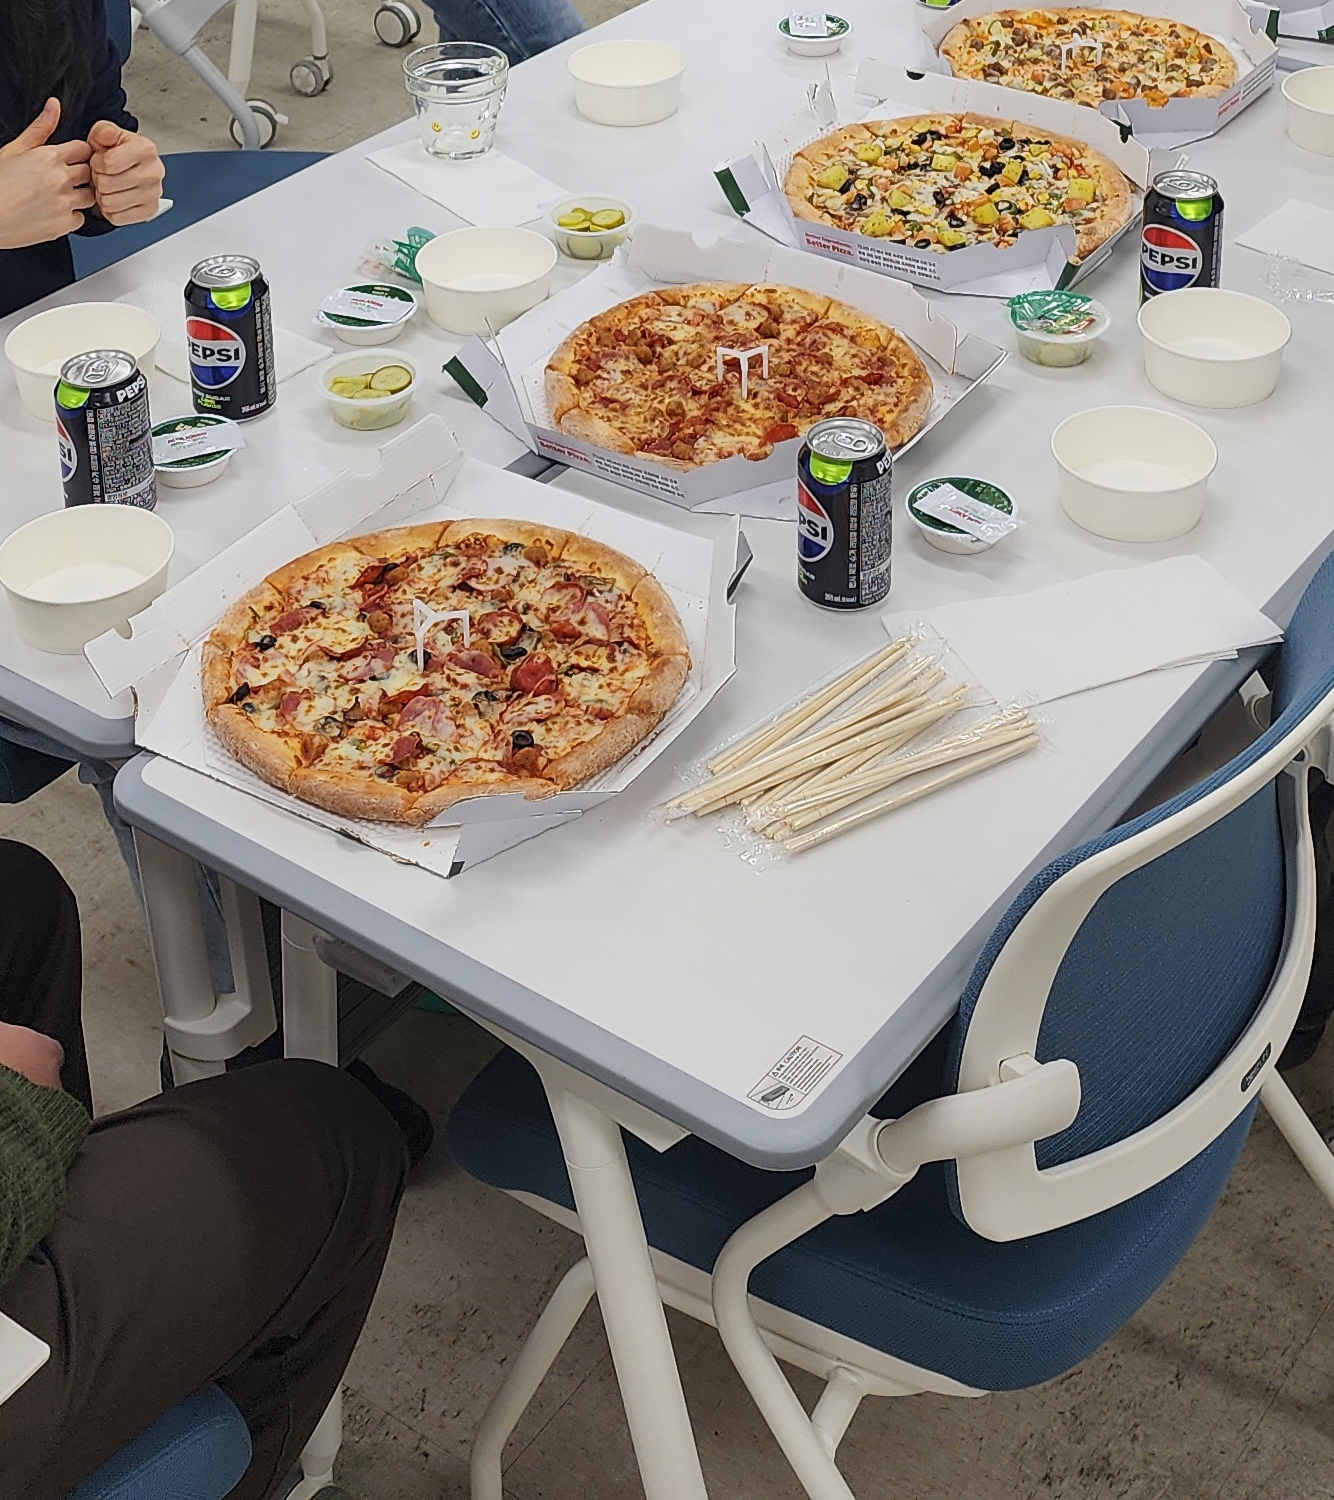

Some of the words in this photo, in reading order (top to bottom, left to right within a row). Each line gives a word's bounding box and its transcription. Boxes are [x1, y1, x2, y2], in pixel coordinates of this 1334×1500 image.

[1141, 240, 1198, 270] PEPSI
[116, 374, 146, 404] PEPS
[798, 510, 828, 542] PSI
